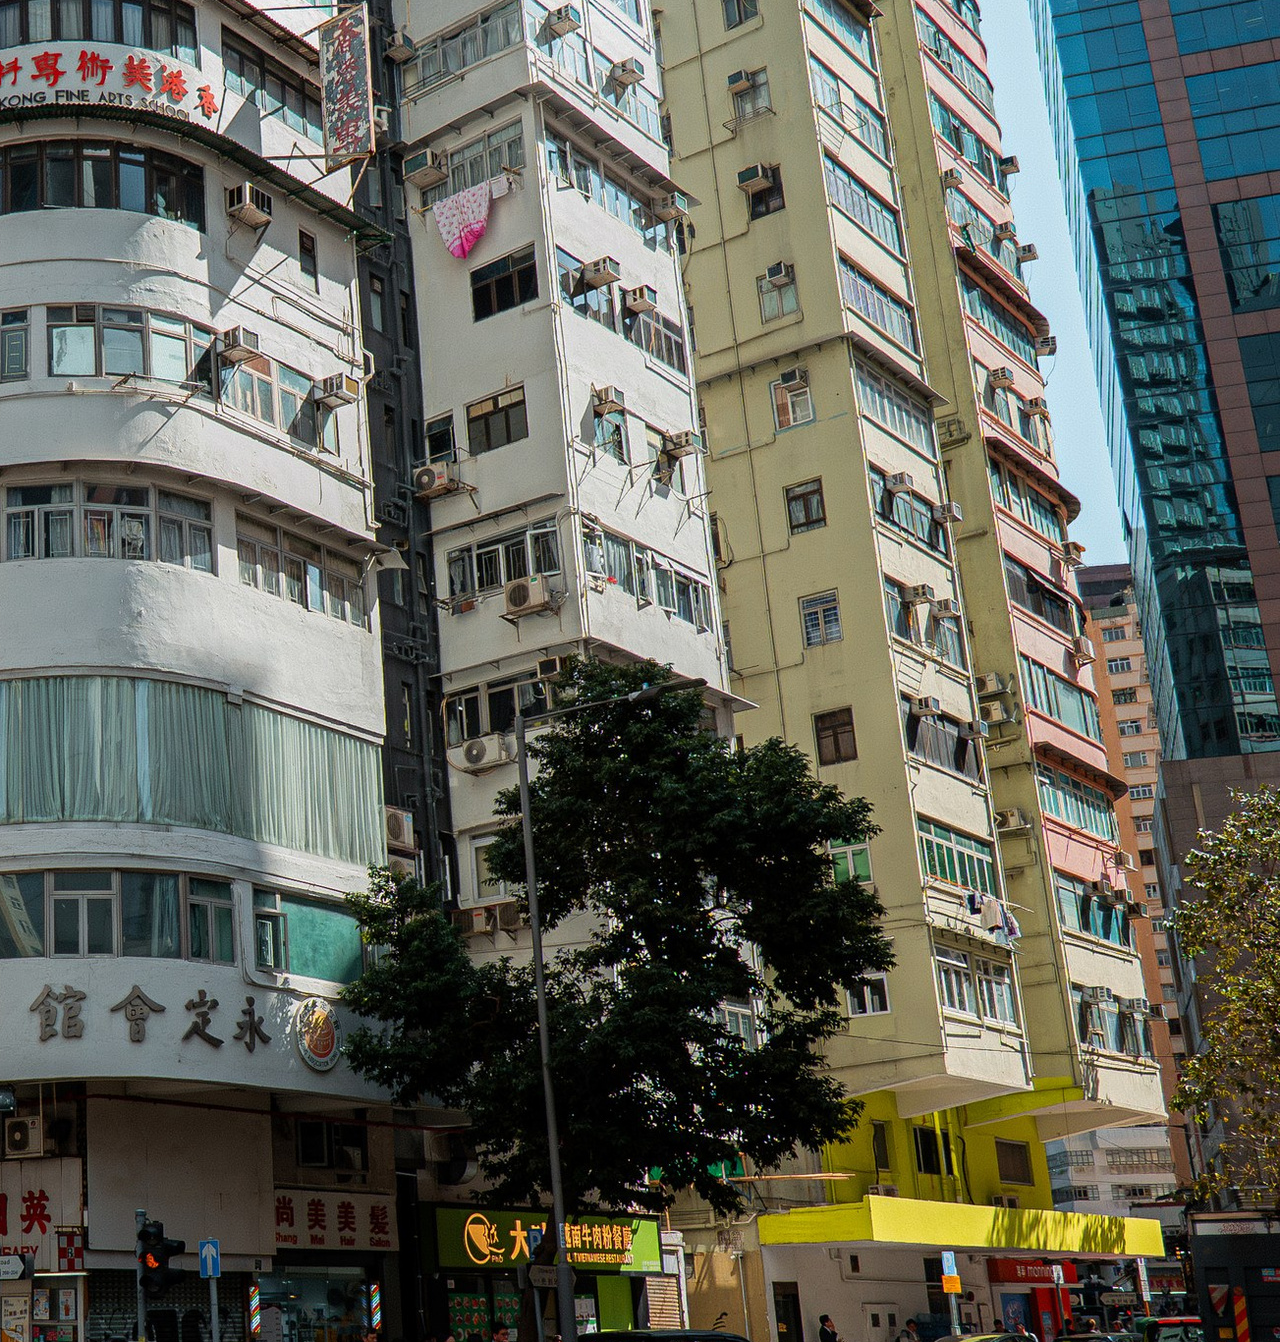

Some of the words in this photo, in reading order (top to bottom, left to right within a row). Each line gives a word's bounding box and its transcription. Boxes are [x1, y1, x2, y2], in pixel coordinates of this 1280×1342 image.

[55, 88, 90, 102] FINE
[100, 91, 133, 106] ARTS
[141, 97, 190, 122] SCHOOL
[29, 983, 273, 1054] 永定會館
[276, 1196, 389, 1235] 尚美美髮
[310, 1234, 325, 1245] Mei
[340, 1235, 356, 1246] Hair
[370, 1237, 391, 1248] Salon
